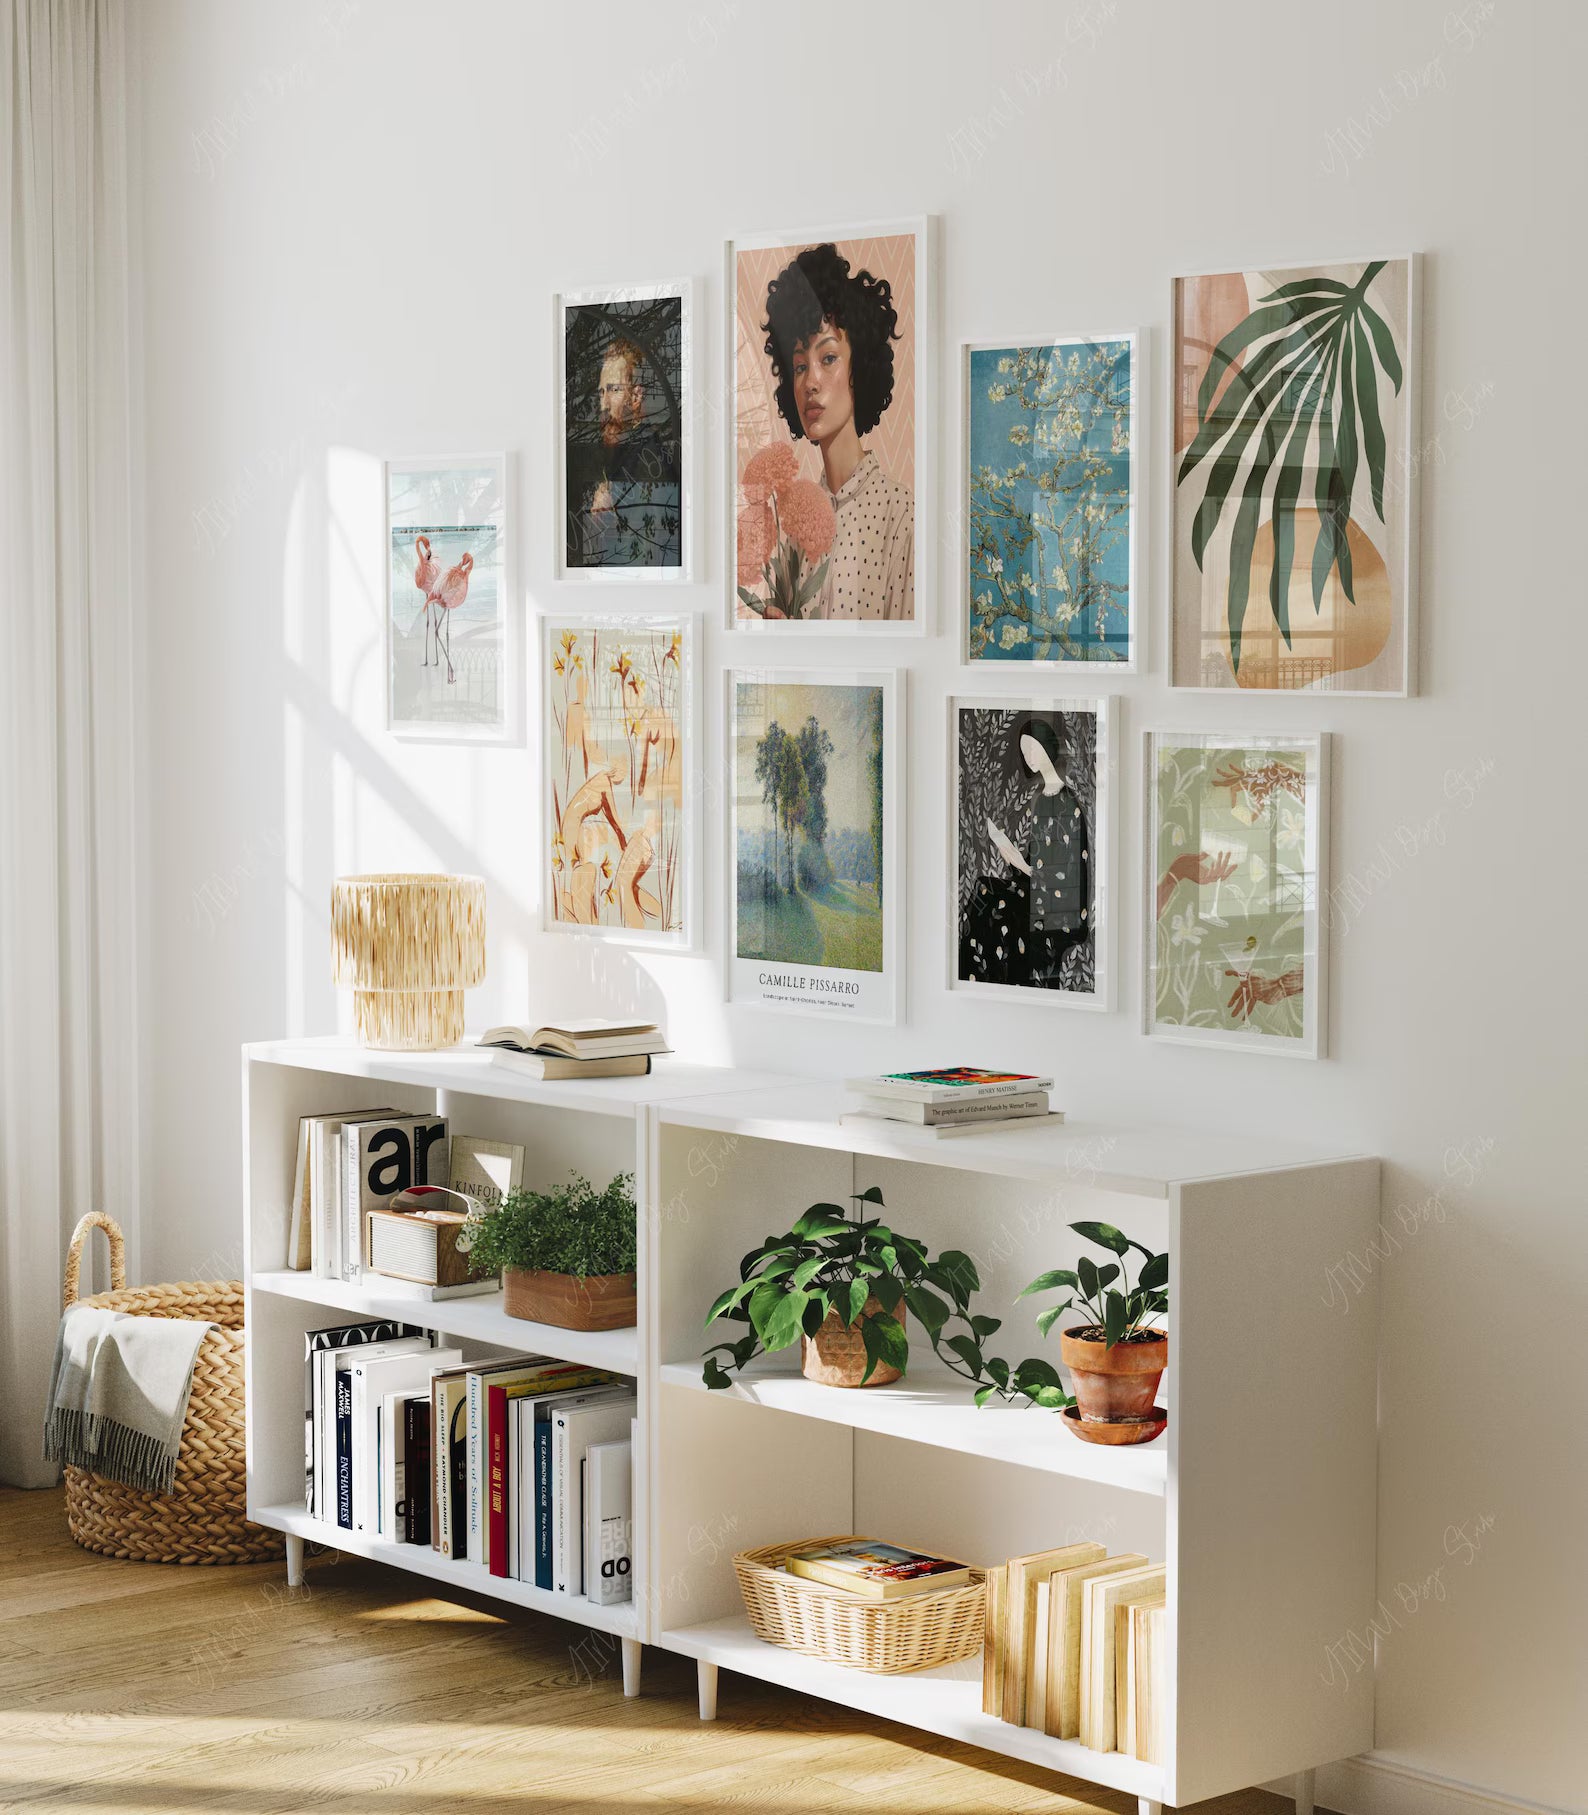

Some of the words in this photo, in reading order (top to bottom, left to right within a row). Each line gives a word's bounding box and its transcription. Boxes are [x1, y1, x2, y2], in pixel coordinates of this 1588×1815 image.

[759, 973, 806, 989] CAMILLE
[809, 978, 860, 995] PISSARRO
[978, 1087, 995, 1095] HENRY
[996, 1085, 1017, 1093] MATISSE
[971, 1104, 987, 1112] Edvard
[987, 1103, 1002, 1111] Munch
[367, 1123, 444, 1196] ar
[471, 1468, 478, 1482] of
[492, 1466, 501, 1482] BOY
[340, 1456, 350, 1523] ENCHANTRESS
[492, 1490, 502, 1513] ABOUT
